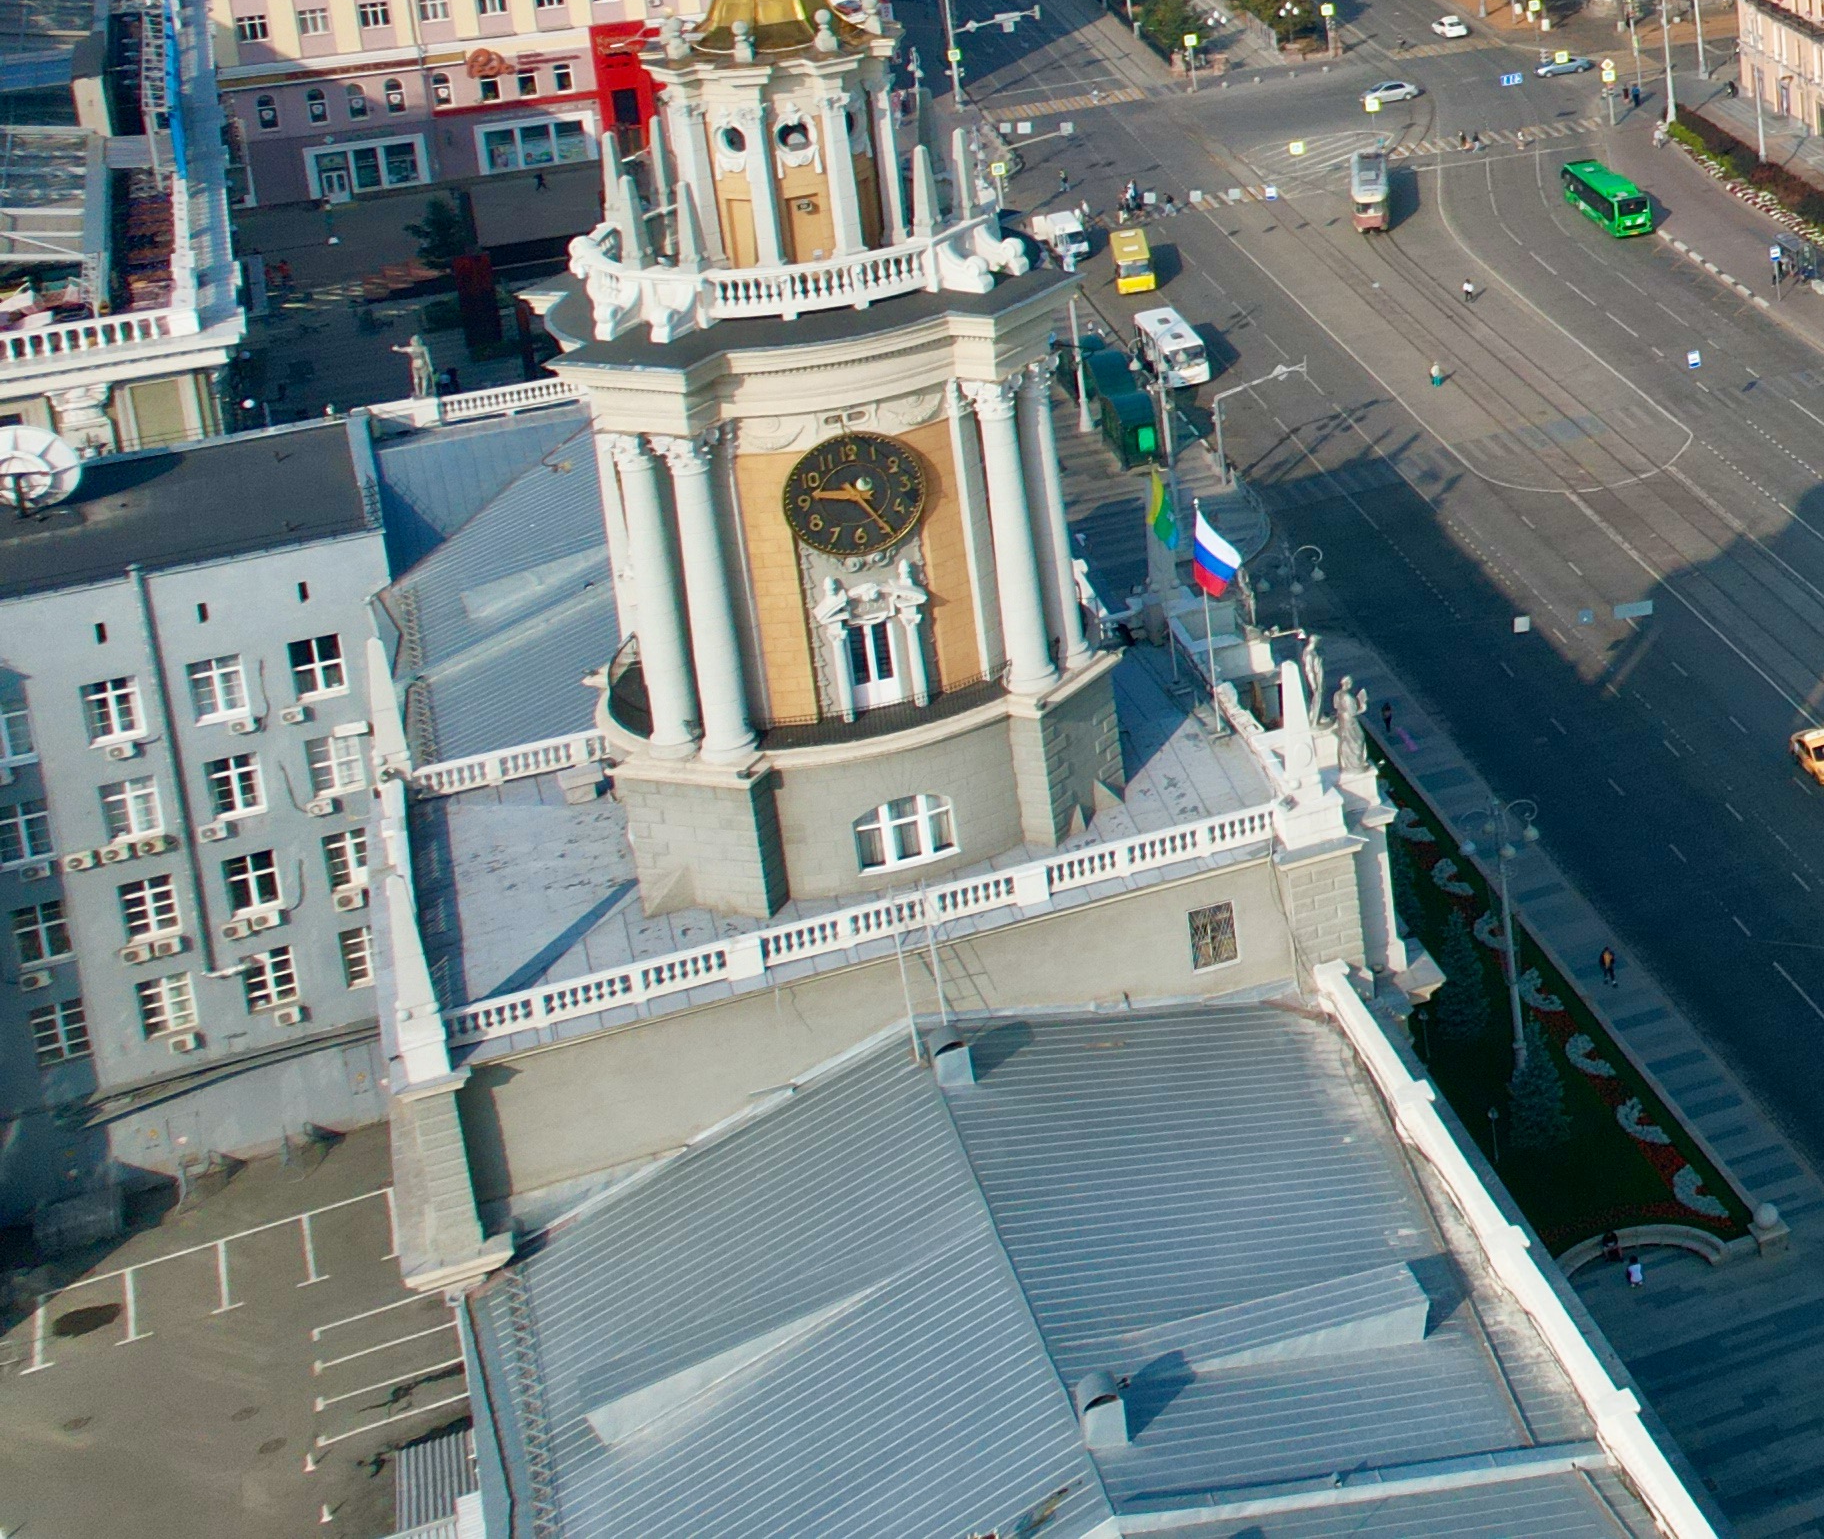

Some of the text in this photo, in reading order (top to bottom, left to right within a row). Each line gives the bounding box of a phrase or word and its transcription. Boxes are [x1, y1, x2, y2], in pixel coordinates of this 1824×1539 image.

[839, 444, 858, 462] 12
[870, 445, 876, 461] 1
[819, 453, 833, 471] 11
[887, 456, 899, 474] 2
[801, 472, 821, 489] 10
[899, 475, 912, 492] 3
[797, 495, 811, 512] 9
[893, 498, 905, 515] 4
[809, 514, 824, 532] 8
[830, 526, 842, 543] 7
[854, 527, 868, 544] 6
